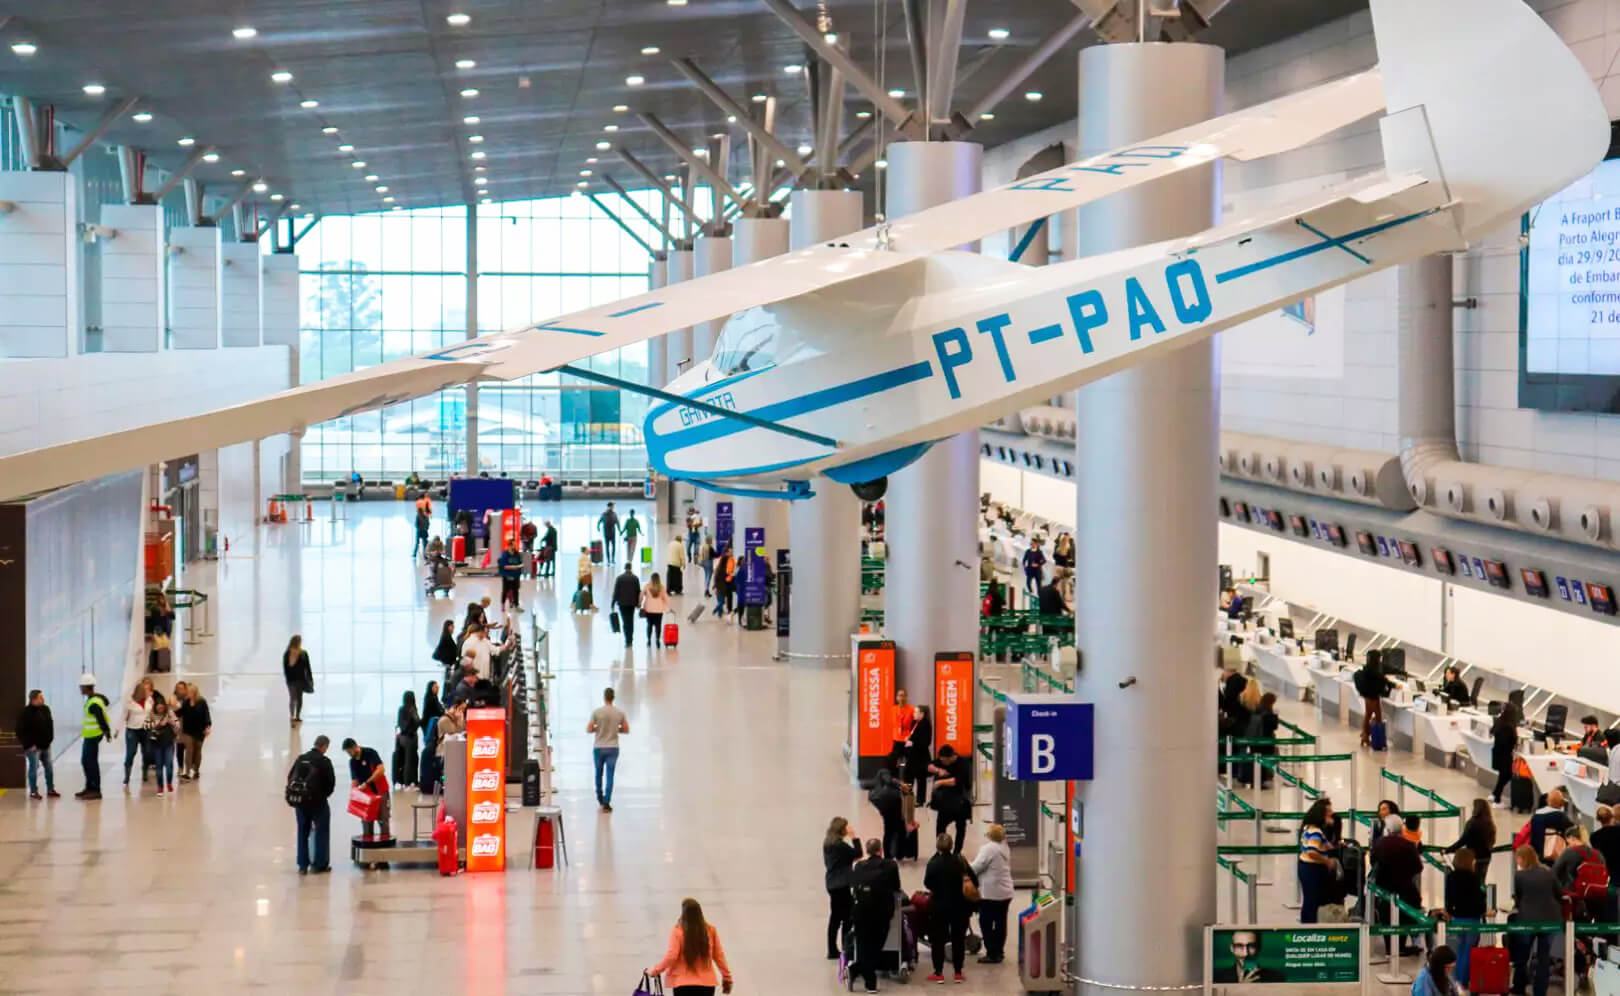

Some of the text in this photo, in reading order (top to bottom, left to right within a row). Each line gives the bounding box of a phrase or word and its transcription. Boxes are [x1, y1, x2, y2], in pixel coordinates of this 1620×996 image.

[1561, 212, 1569, 226] A
[1572, 209, 1611, 229] Fraport
[1559, 233, 1588, 246] Porto
[1558, 251, 1574, 266] dia
[1569, 271, 1583, 285] de
[1591, 310, 1603, 324] 21
[931, 258, 1213, 399] PT-PAQ
[868, 667, 881, 729] EXPRESSA
[945, 680, 958, 740] BAGAGEM
[1031, 733, 1056, 774] B
[1292, 933, 1327, 942] Localiza
